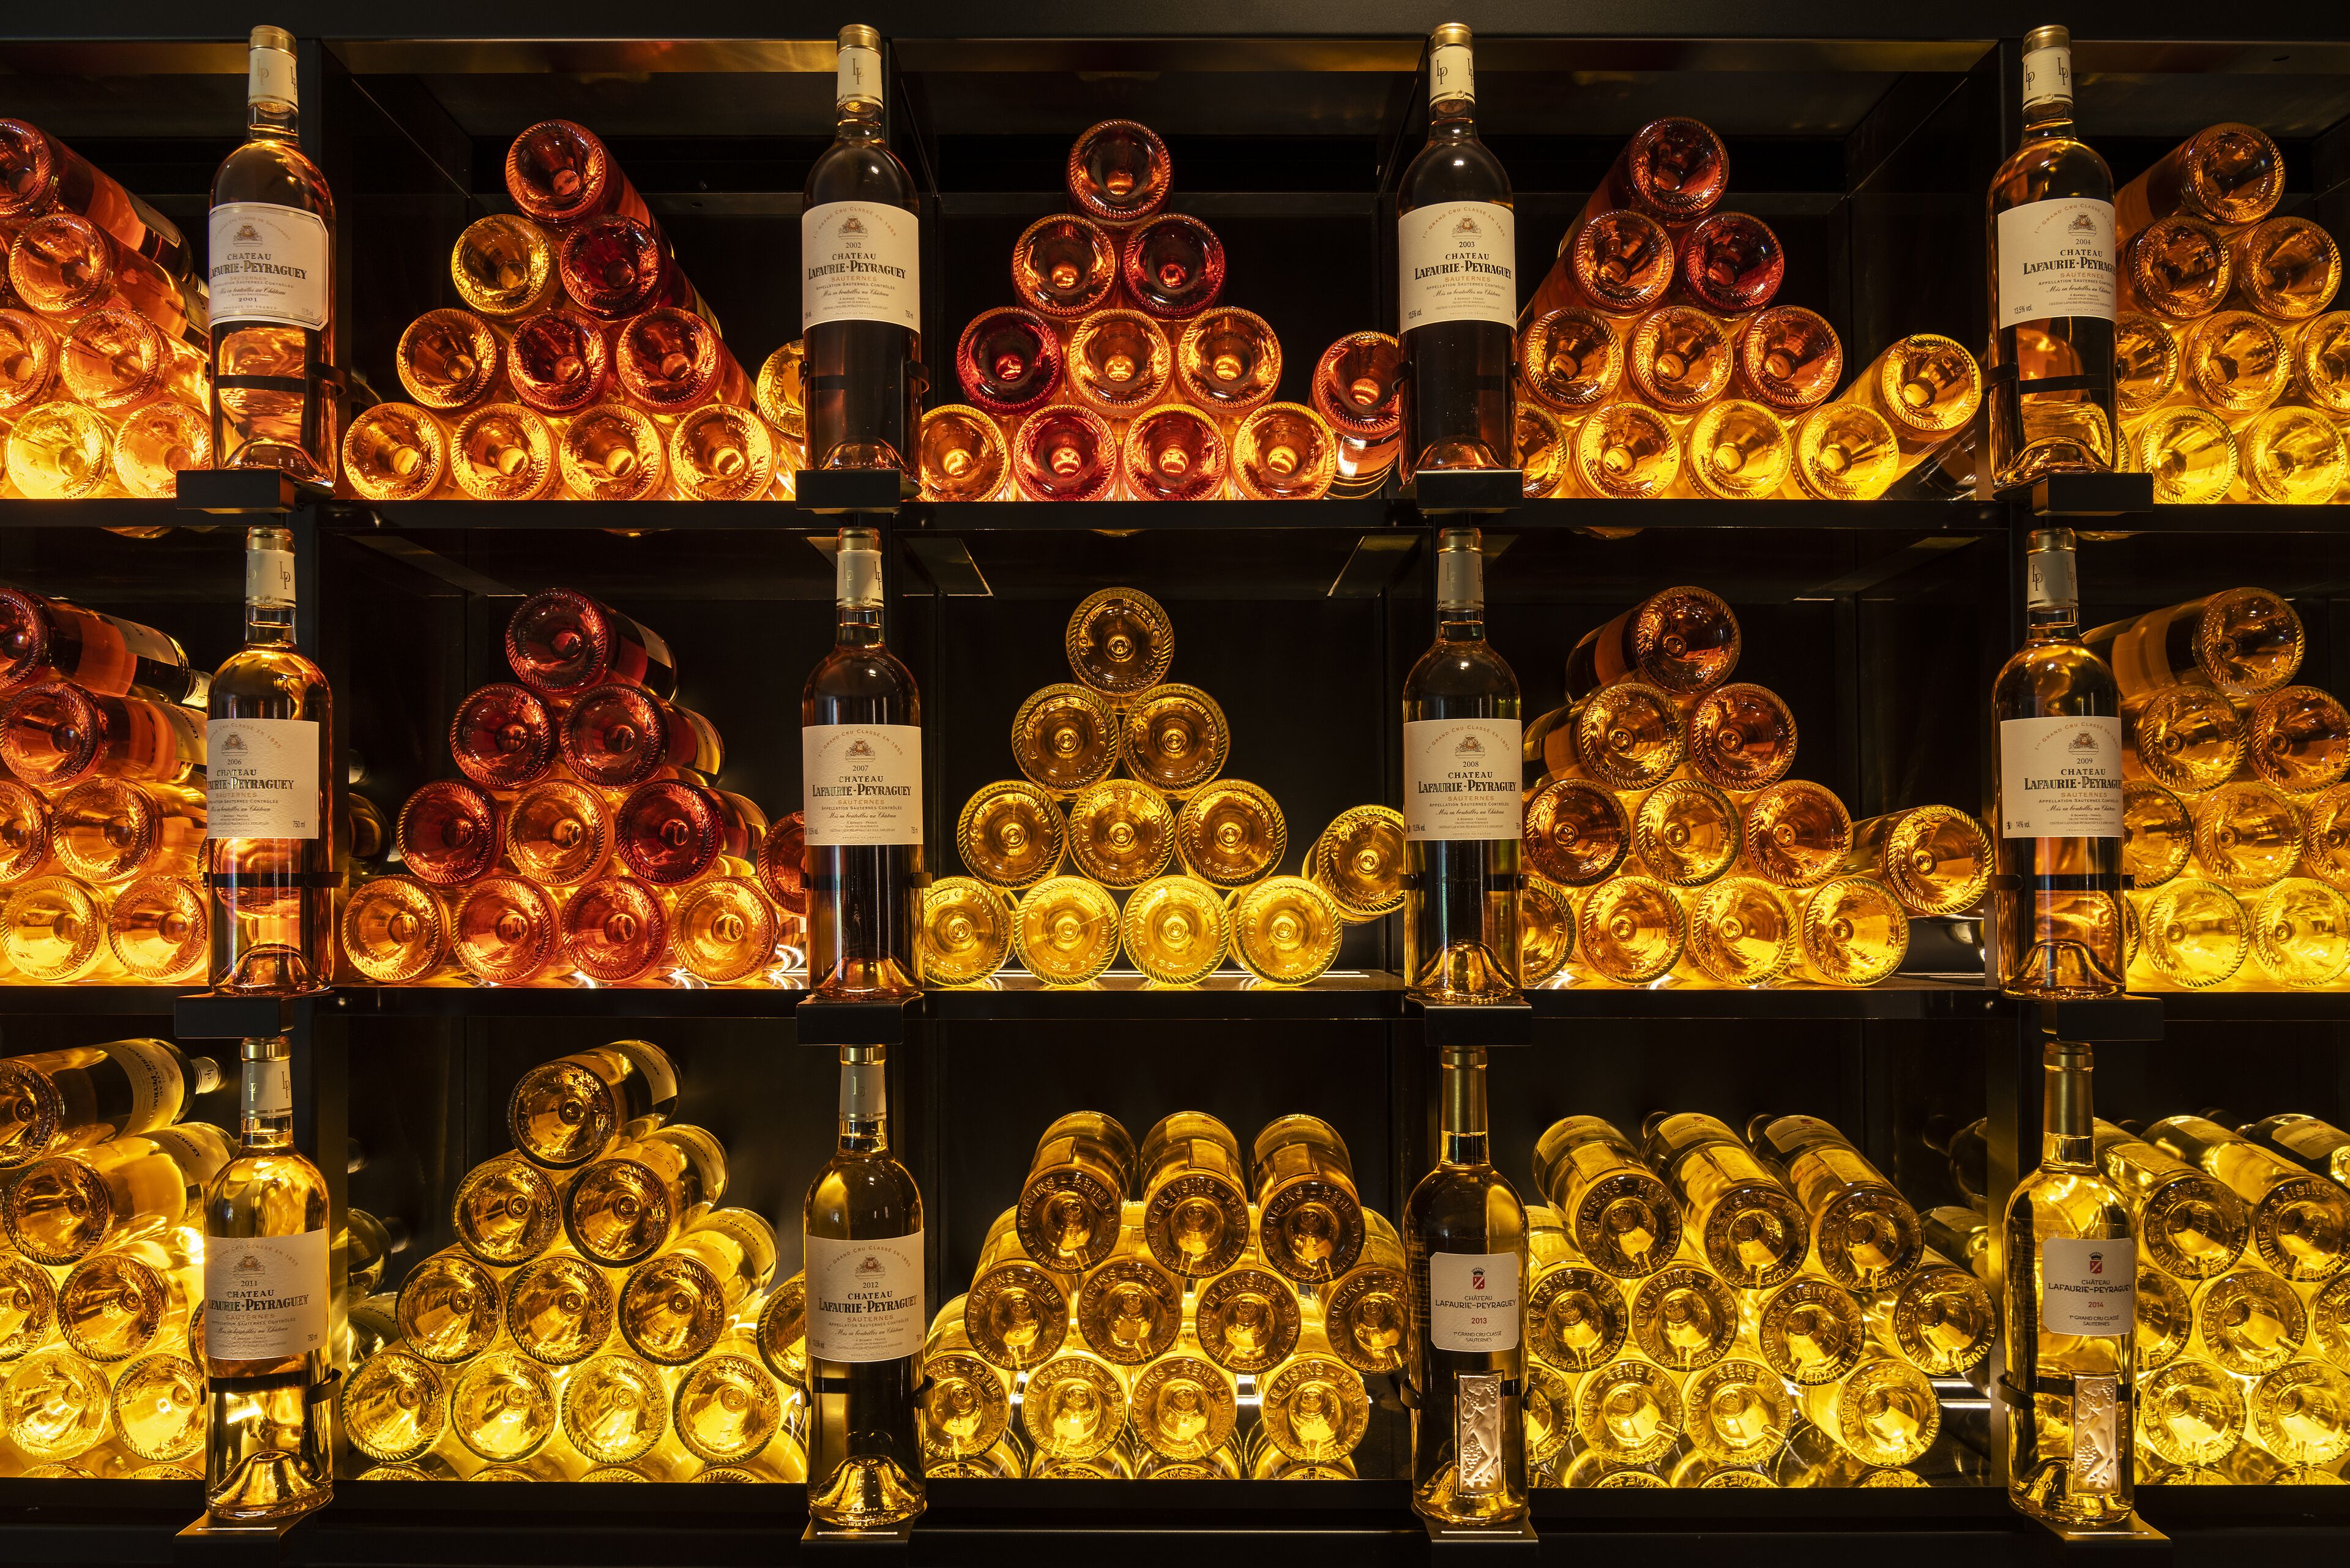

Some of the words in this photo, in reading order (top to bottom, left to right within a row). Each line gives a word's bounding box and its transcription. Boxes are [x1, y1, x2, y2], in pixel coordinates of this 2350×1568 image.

[2042, 209, 2062, 225] GRAND
[885, 222, 897, 237] 1855
[1428, 214, 1445, 230] GRAND
[1496, 222, 1505, 237] 1855
[808, 260, 906, 280] LAFAURIE-PEYRAGUEY
[1415, 260, 1512, 280] LAFAURIE-PEYRAGUEY
[2023, 256, 2115, 275] LAFAURIE-PEYRAGUE
[2014, 305, 2025, 315] 13,5%
[1431, 731, 1449, 745] GRAND
[1500, 738, 1510, 751] 1855
[2042, 728, 2062, 742] GRAND
[267, 736, 282, 749] 1855
[824, 736, 839, 749] GRAND
[892, 742, 903, 755] 1855
[812, 783, 911, 797] LAFAURIE-PEYRAGUEY
[1419, 780, 1516, 793] LAFAURIE-PEYRAGUEY
[2024, 777, 2122, 790] LAFAURIE-PEYRAGUE
[285, 1254, 299, 1267] 1855
[833, 1252, 851, 1264] GRAND
[901, 1255, 911, 1267] 1855
[227, 1290, 274, 1298] CHATEAU
[2048, 1283, 2132, 1293] LAFAURIE-PEYRAGUEY
[848, 1291, 892, 1300] CHATEAU
[819, 1295, 917, 1313] LAFAURIE-PEYRAGUEY
[1435, 1299, 1516, 1309] LAFAURIE-PEYRAGUEY
